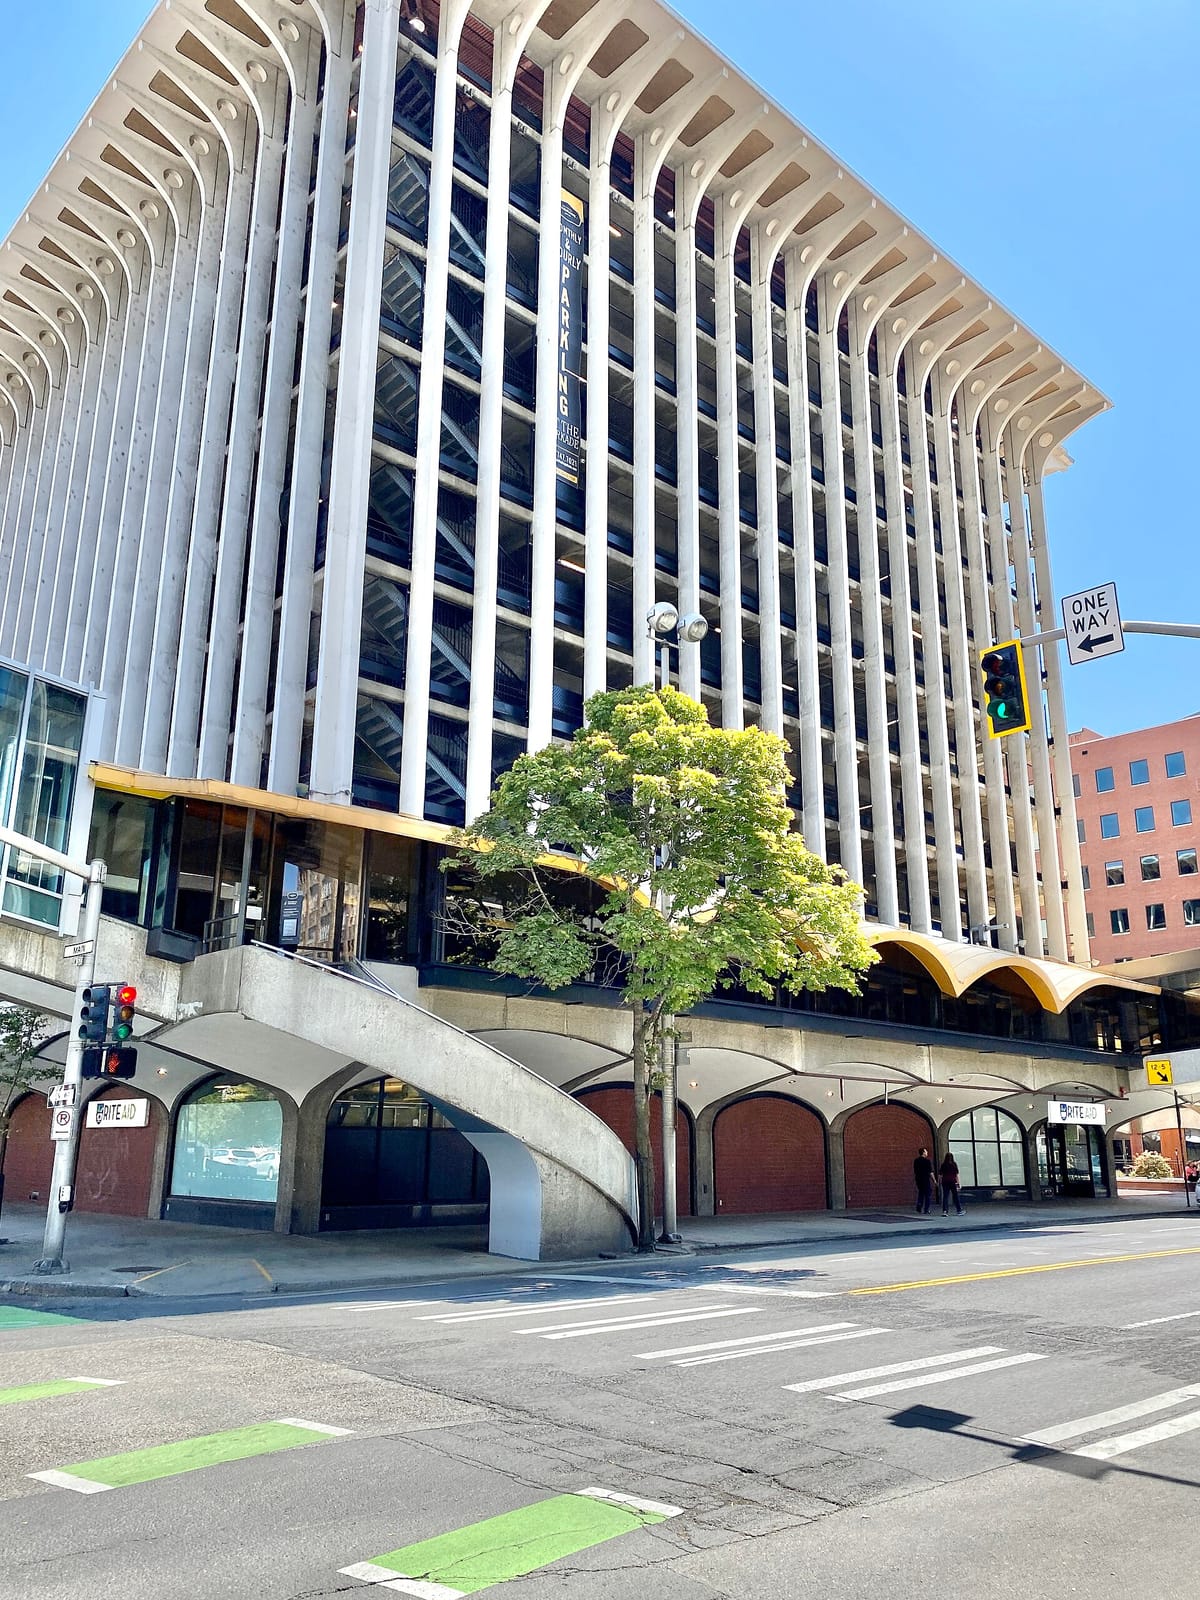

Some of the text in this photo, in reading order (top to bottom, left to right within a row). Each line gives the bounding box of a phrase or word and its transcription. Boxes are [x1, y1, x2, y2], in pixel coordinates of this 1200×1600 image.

[565, 237, 571, 251] &
[559, 263, 571, 417] PARKING
[561, 420, 580, 440] THE
[1072, 591, 1108, 615] ONE
[1072, 609, 1110, 634] WAY
[103, 1103, 137, 1121] RITE AID
[1067, 1105, 1098, 1119] RITE AID
